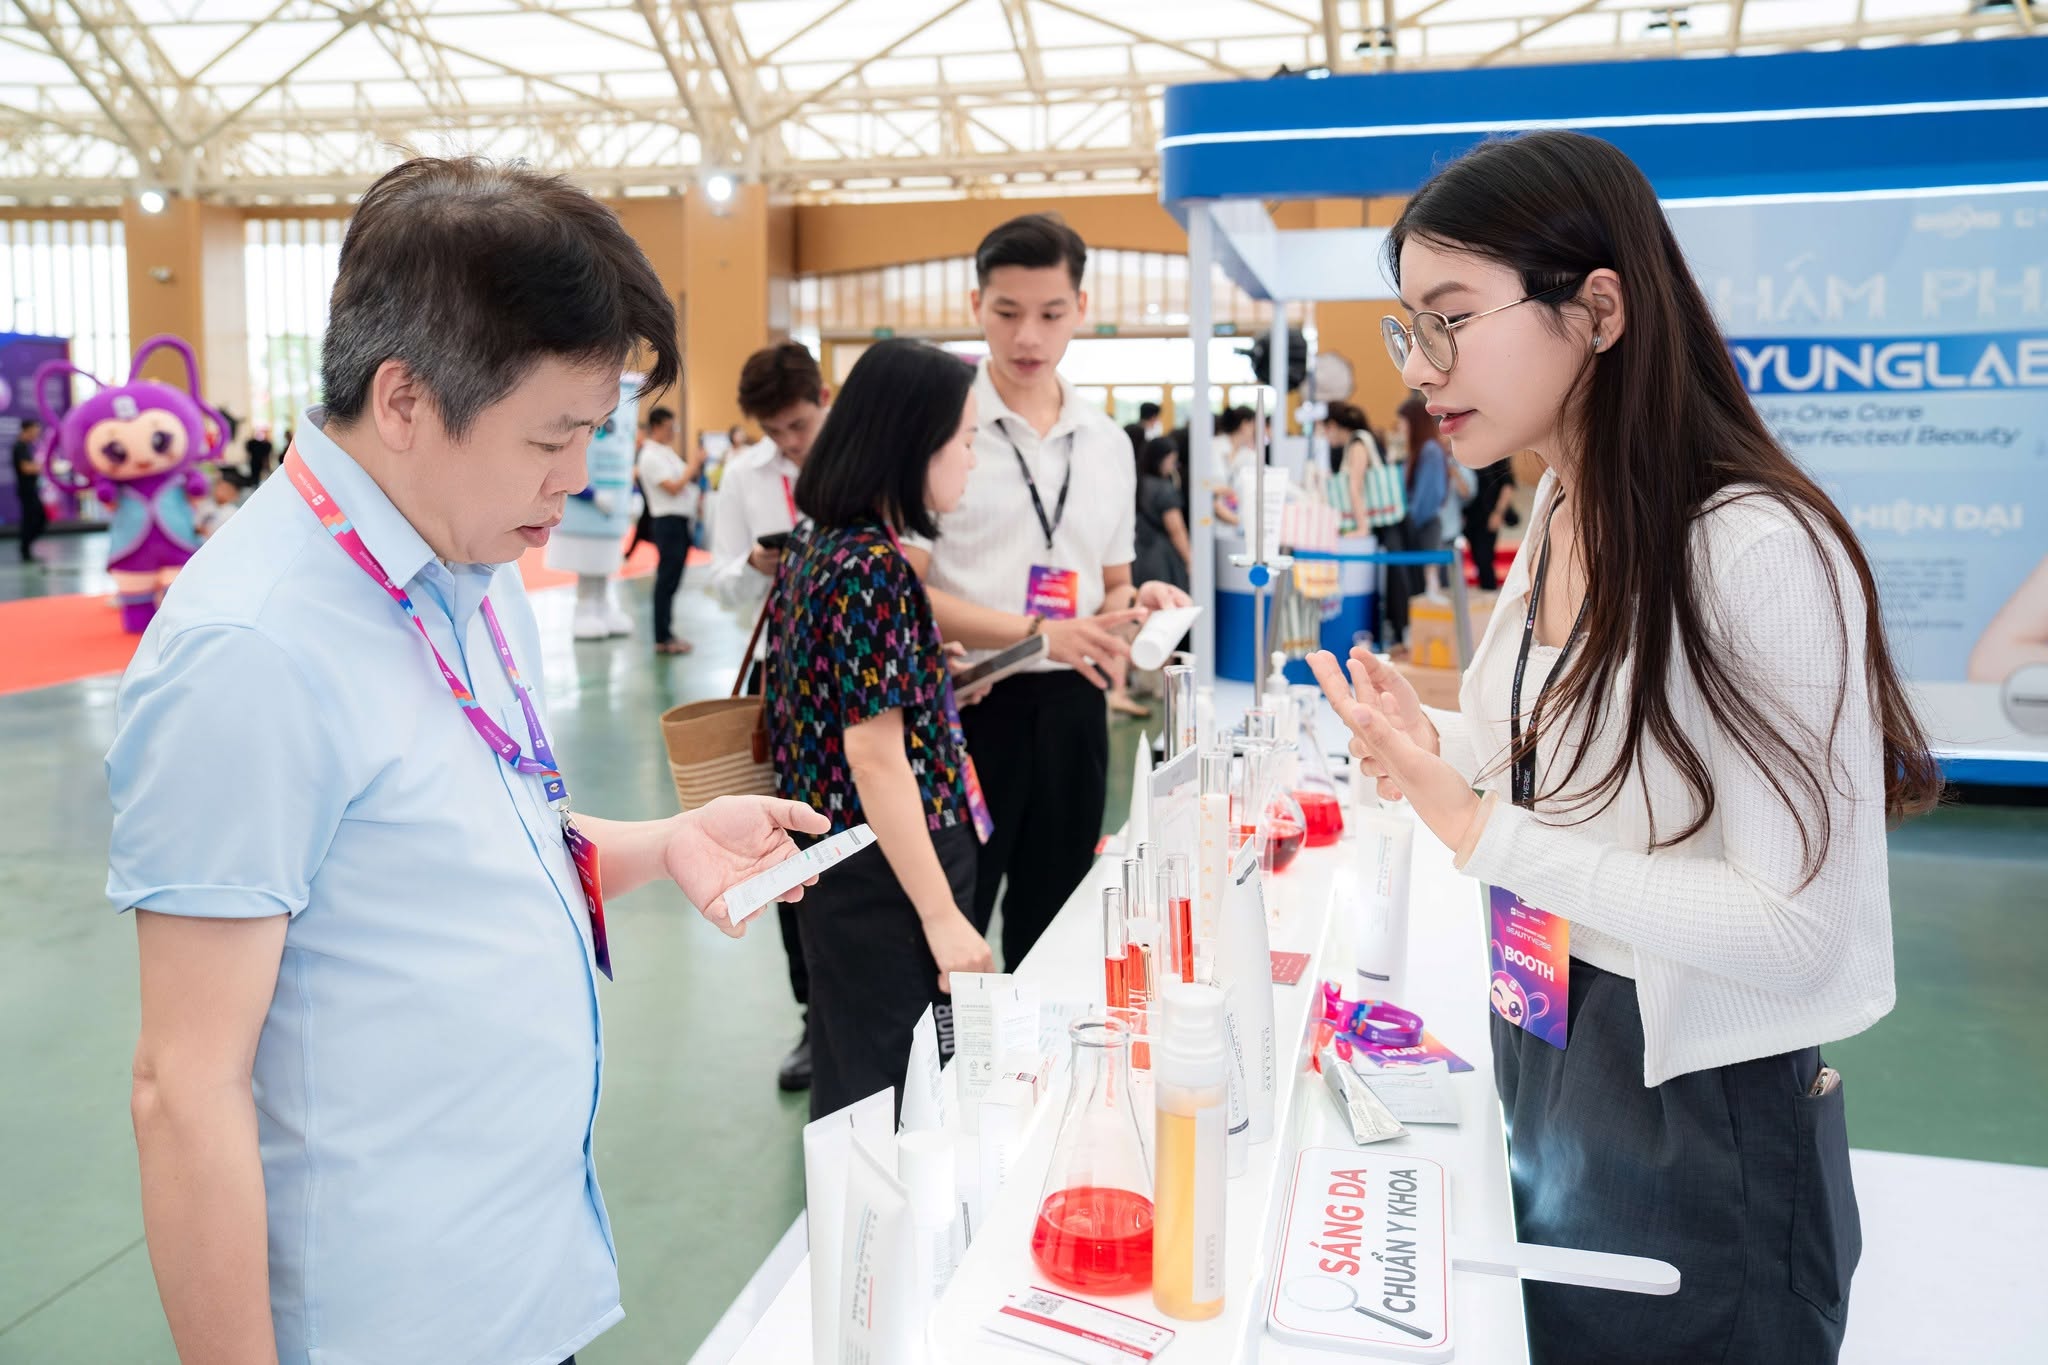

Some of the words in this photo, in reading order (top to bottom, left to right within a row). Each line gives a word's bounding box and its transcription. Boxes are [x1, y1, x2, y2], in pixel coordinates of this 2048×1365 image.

[1715, 251, 1886, 322] HÁM
[1921, 265, 2048, 320] PH
[1733, 338, 2048, 391] YUNGLAB
[1858, 402, 1923, 422] Care
[1917, 424, 2022, 448] Beauty
[1504, 945, 1555, 982] BOOTH
[1381, 1046, 1428, 1057] RUBY
[1327, 1169, 1368, 1199] DA
[1387, 1169, 1418, 1218] KHOA
[1309, 1204, 1365, 1276] SÁNG
[1386, 1220, 1417, 1233] Y
[1371, 1238, 1417, 1314] CHUẨN
